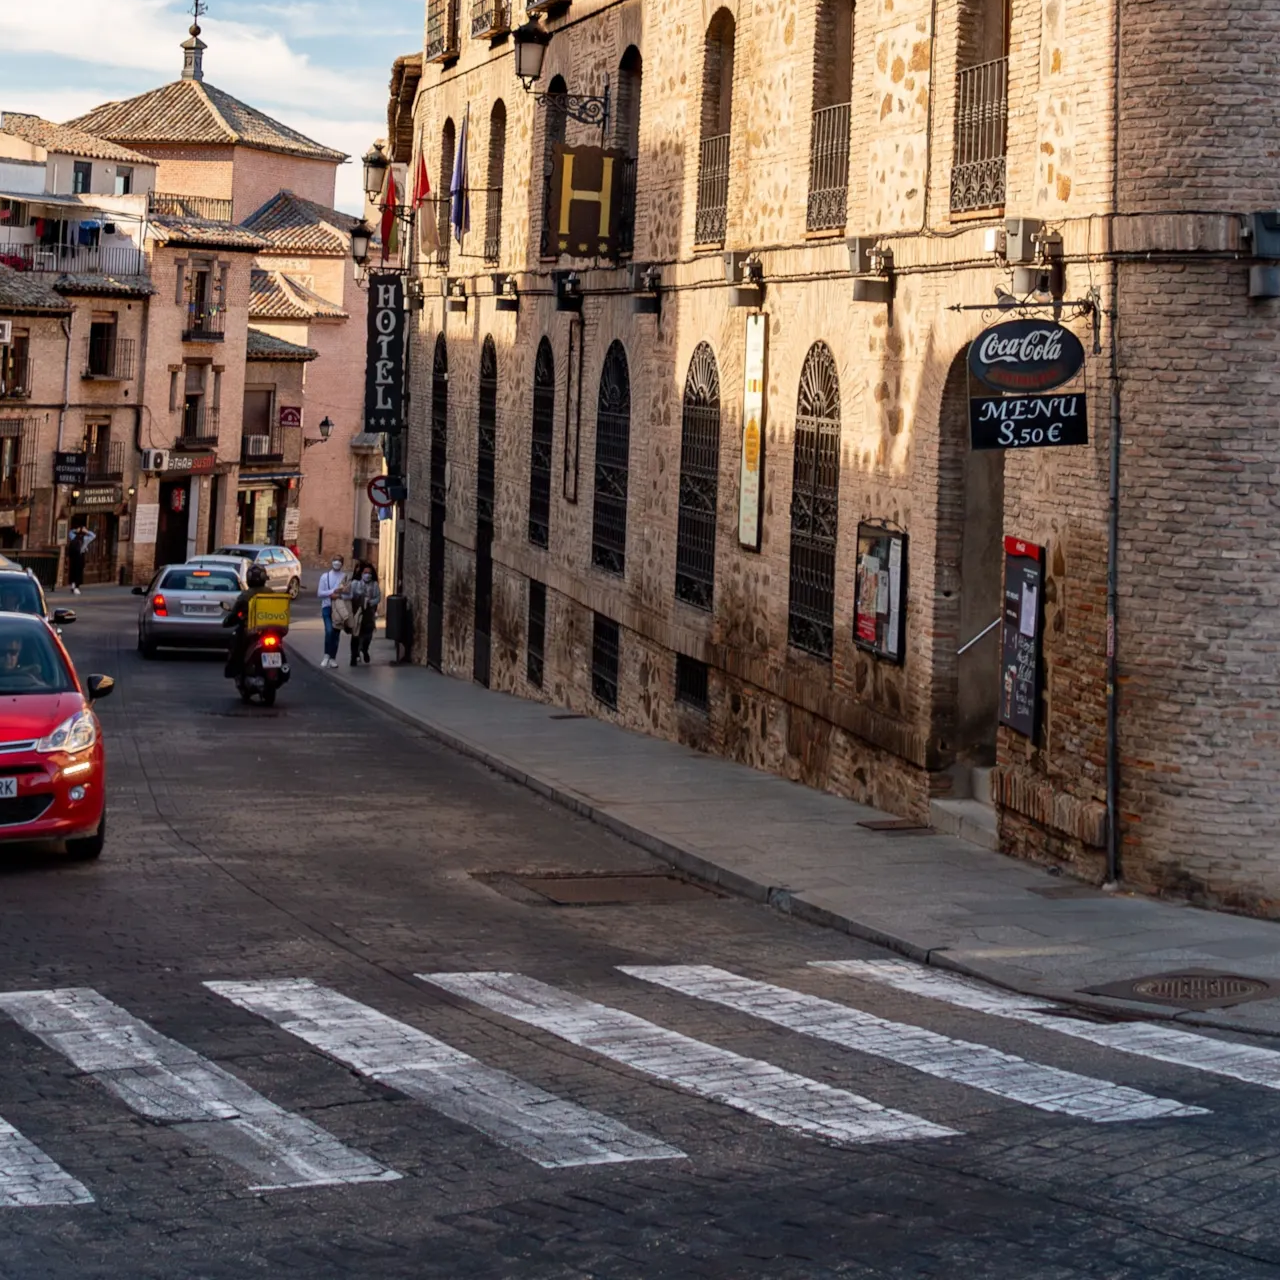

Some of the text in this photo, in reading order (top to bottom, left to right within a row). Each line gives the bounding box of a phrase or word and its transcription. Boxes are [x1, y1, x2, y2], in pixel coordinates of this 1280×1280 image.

[559, 154, 614, 238] H
[376, 284, 396, 409] HOTEL
[980, 329, 1063, 364] Coca-Cola
[979, 396, 1078, 421] MENÚ
[83, 495, 115, 504] ARRABAL
[257, 611, 285, 620] Glovo
